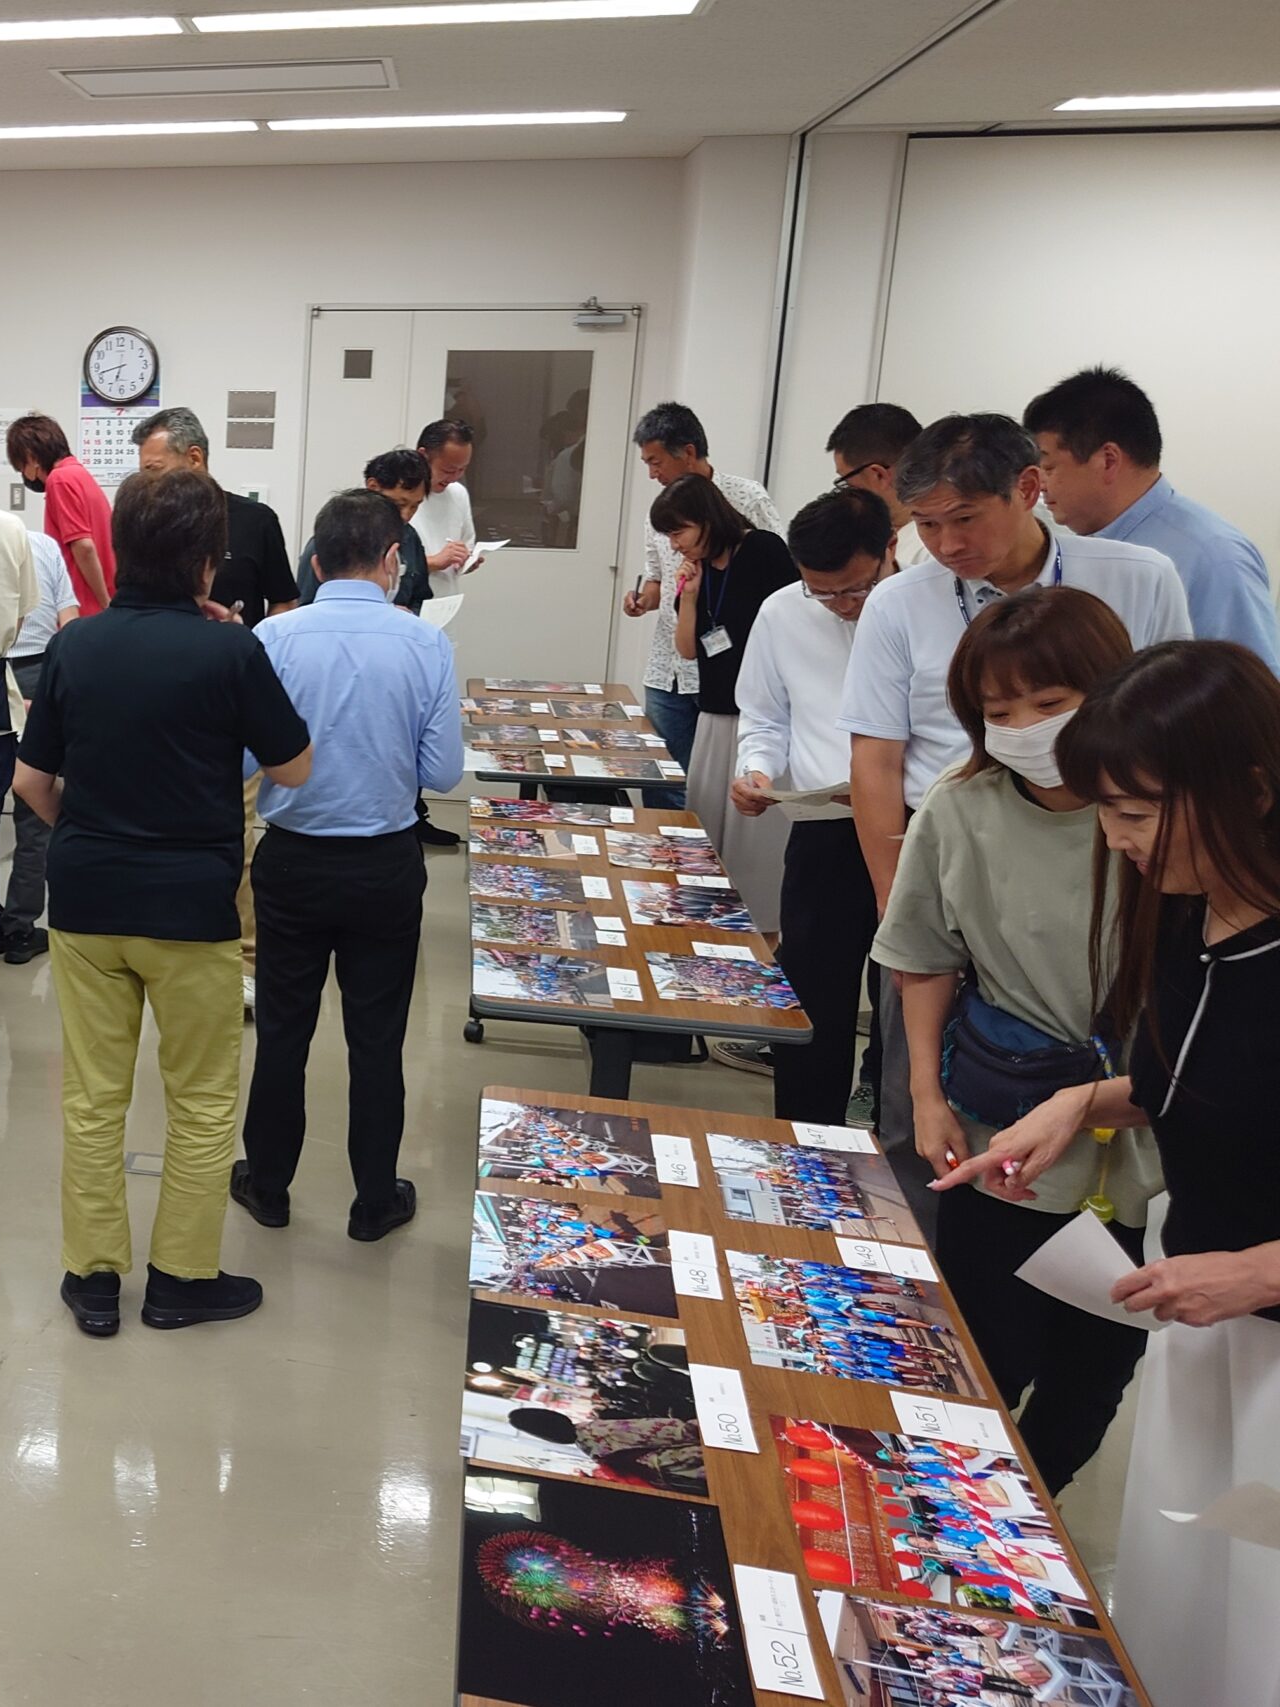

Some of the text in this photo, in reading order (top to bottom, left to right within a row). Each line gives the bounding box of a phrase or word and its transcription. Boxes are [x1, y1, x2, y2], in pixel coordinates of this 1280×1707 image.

[105, 340, 113, 351] 11
[116, 337, 125, 347] 12
[96, 350, 105, 360] 10
